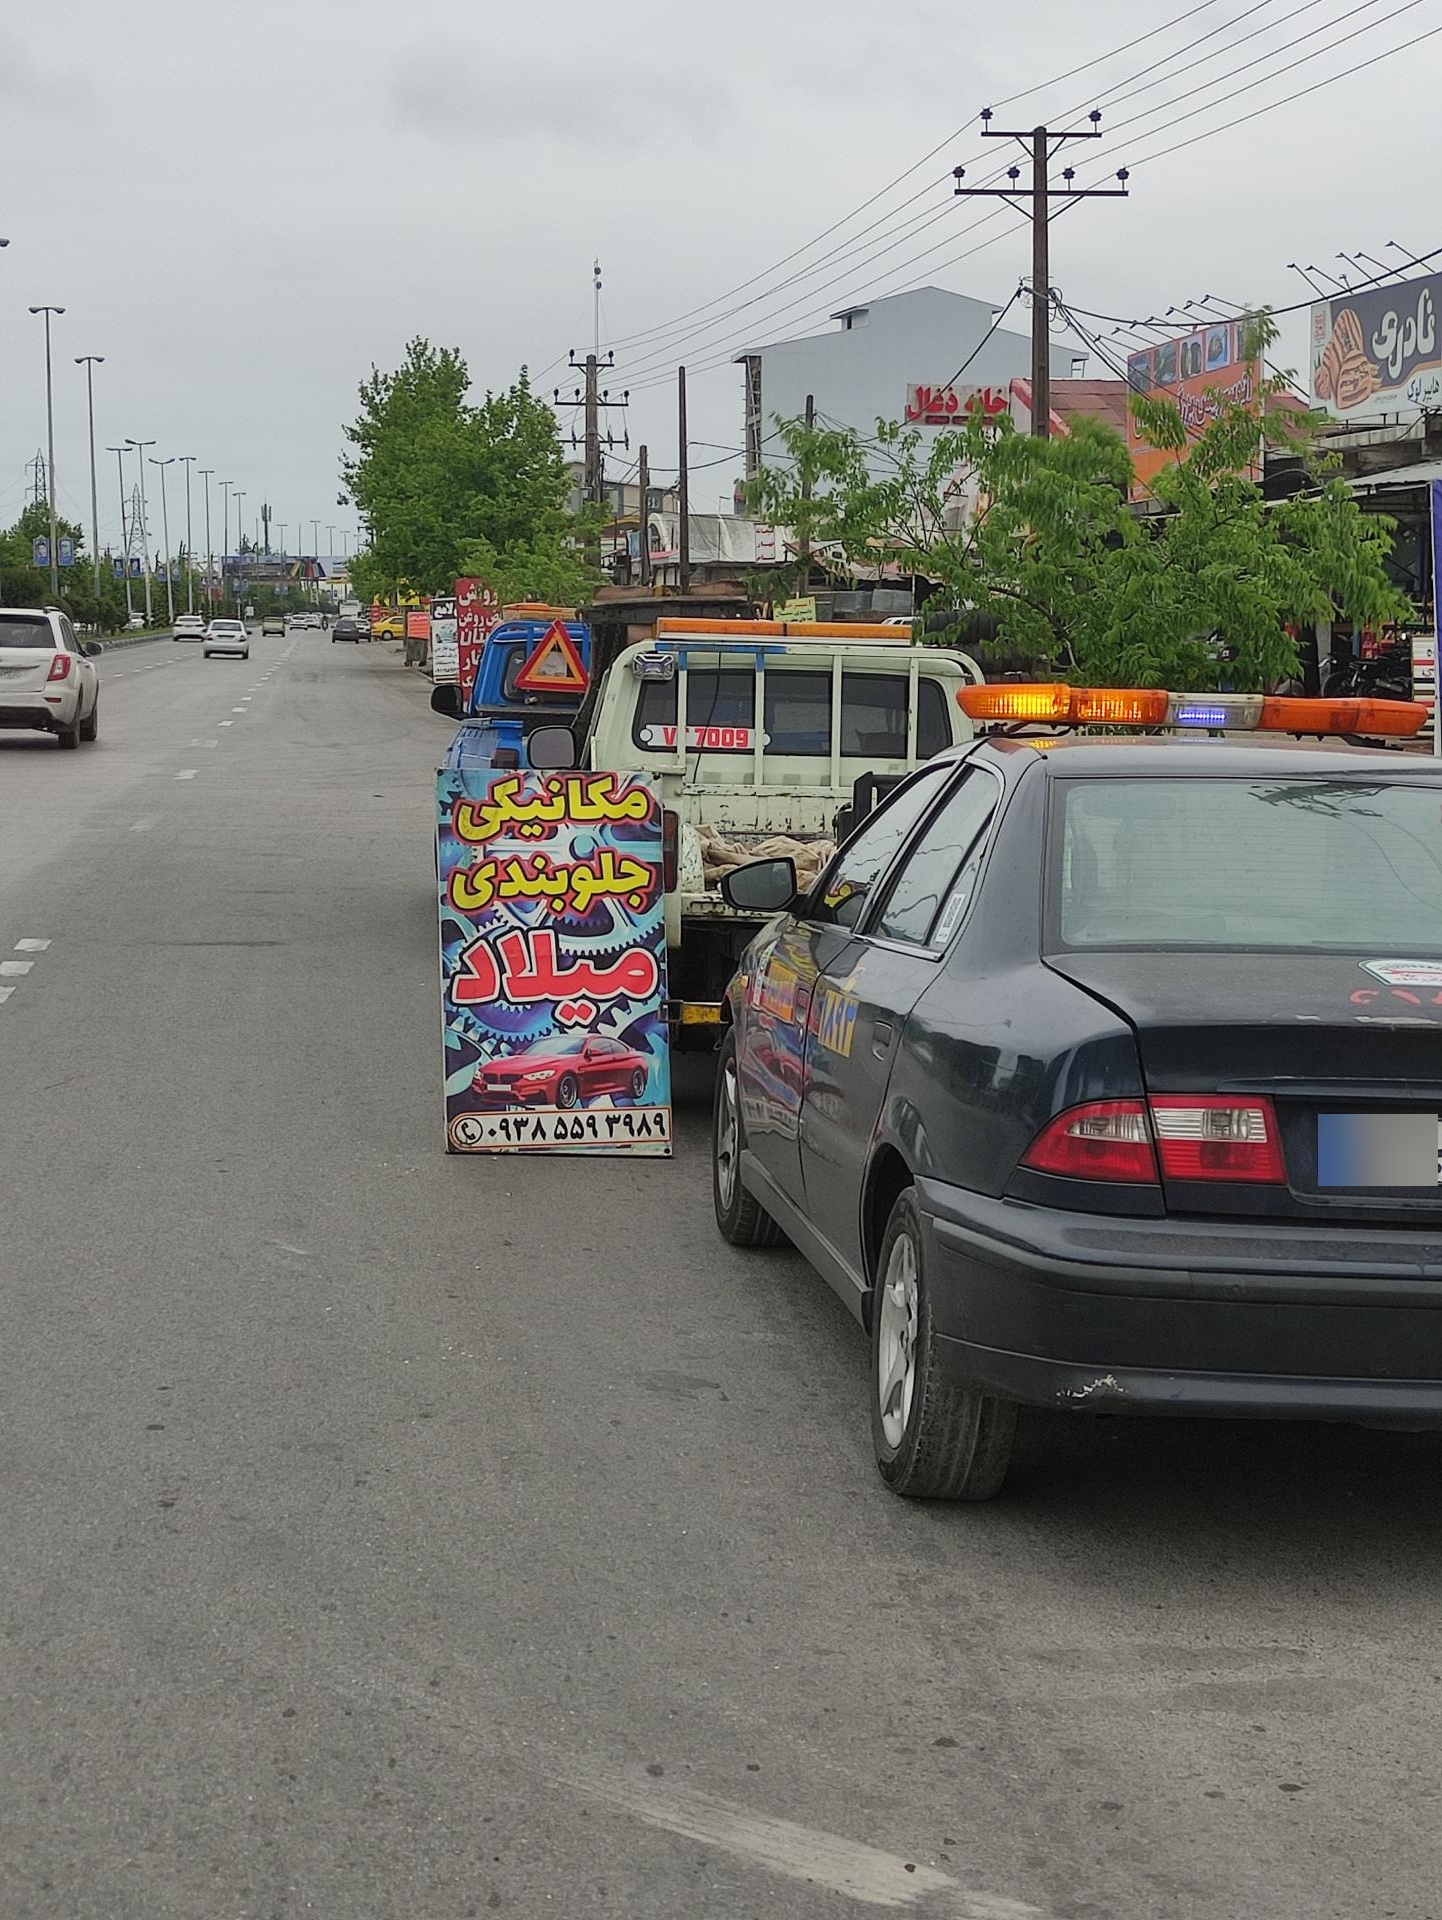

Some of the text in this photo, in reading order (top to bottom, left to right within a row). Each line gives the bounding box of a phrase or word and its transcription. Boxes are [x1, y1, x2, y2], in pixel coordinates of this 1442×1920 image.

[1372, 288, 1435, 379] نادری
[907, 386, 959, 420] ذغال
[458, 608, 485, 627] روغن
[694, 728, 749, 748] 7009
[456, 775, 651, 840] مکانیکی
[452, 851, 652, 912] جلوبندی
[452, 930, 659, 1024] میلاد
[487, 1112, 667, 1142] ۰۹۳۸ ۵۵۹ ۳۹۸۹
